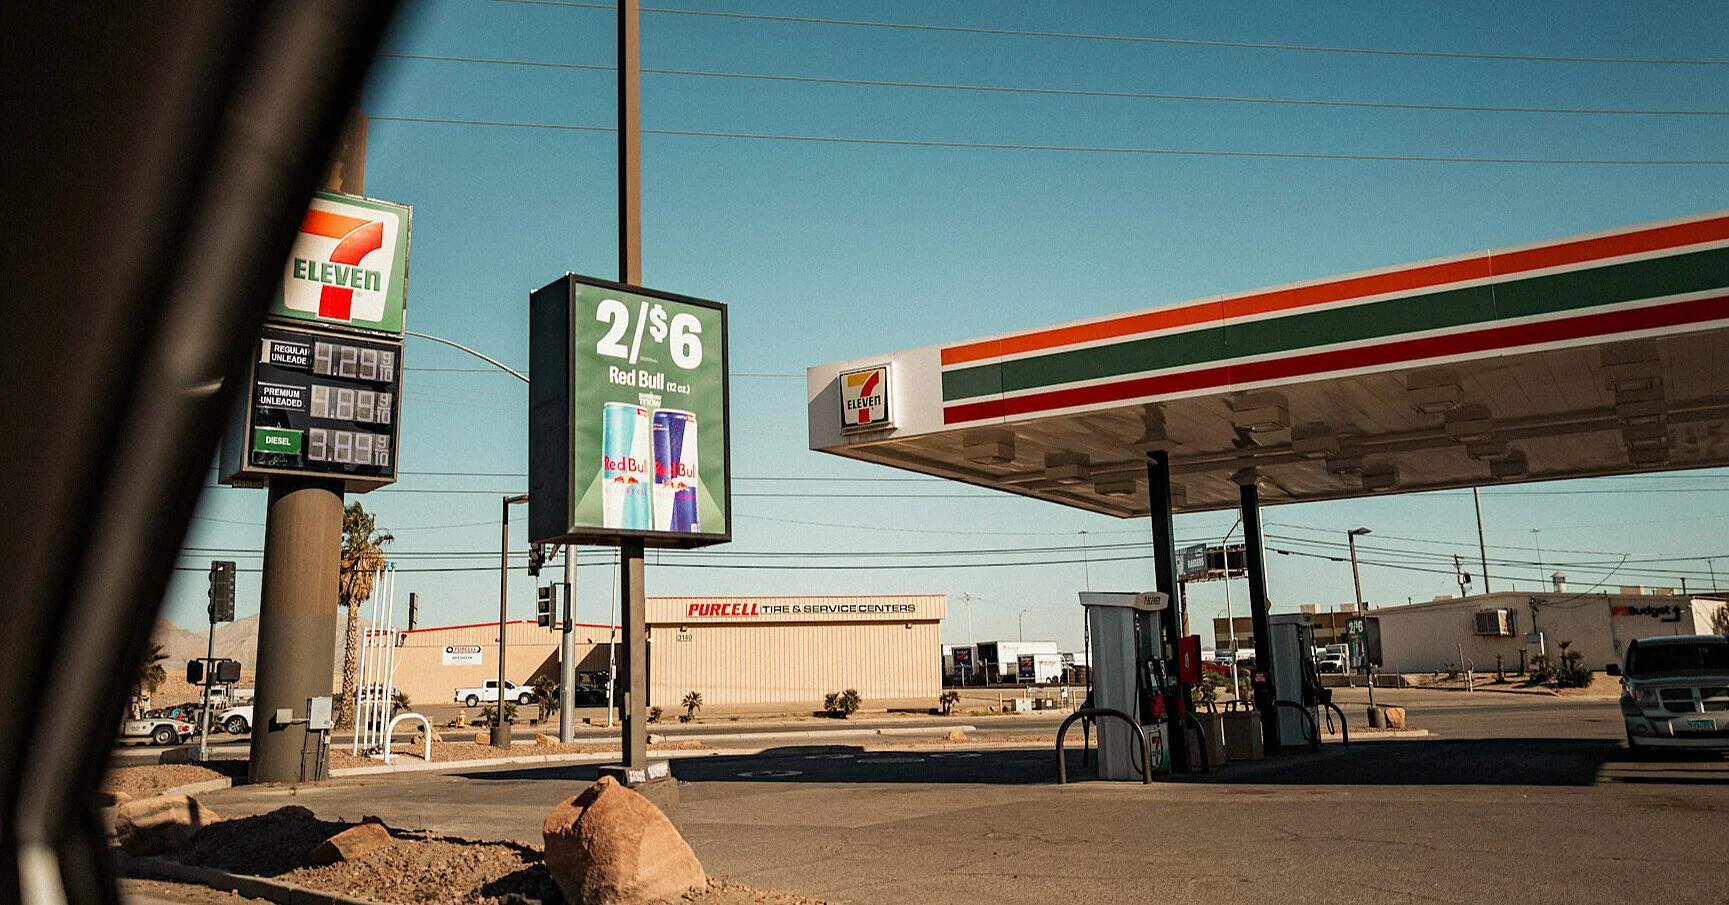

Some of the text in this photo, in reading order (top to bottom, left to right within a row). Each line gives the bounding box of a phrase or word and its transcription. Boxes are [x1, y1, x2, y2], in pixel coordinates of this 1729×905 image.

[609, 365, 636, 387] Red
[639, 370, 665, 390] Bull
[263, 387, 301, 399] PREMIUM
[260, 397, 303, 408] UNLEADED
[265, 435, 292, 446] DIESEL
[604, 455, 626, 471] Red
[688, 603, 916, 617] PURCELL TIRE & SERVICE CENTERS
[1628, 605, 1670, 617] Budget
